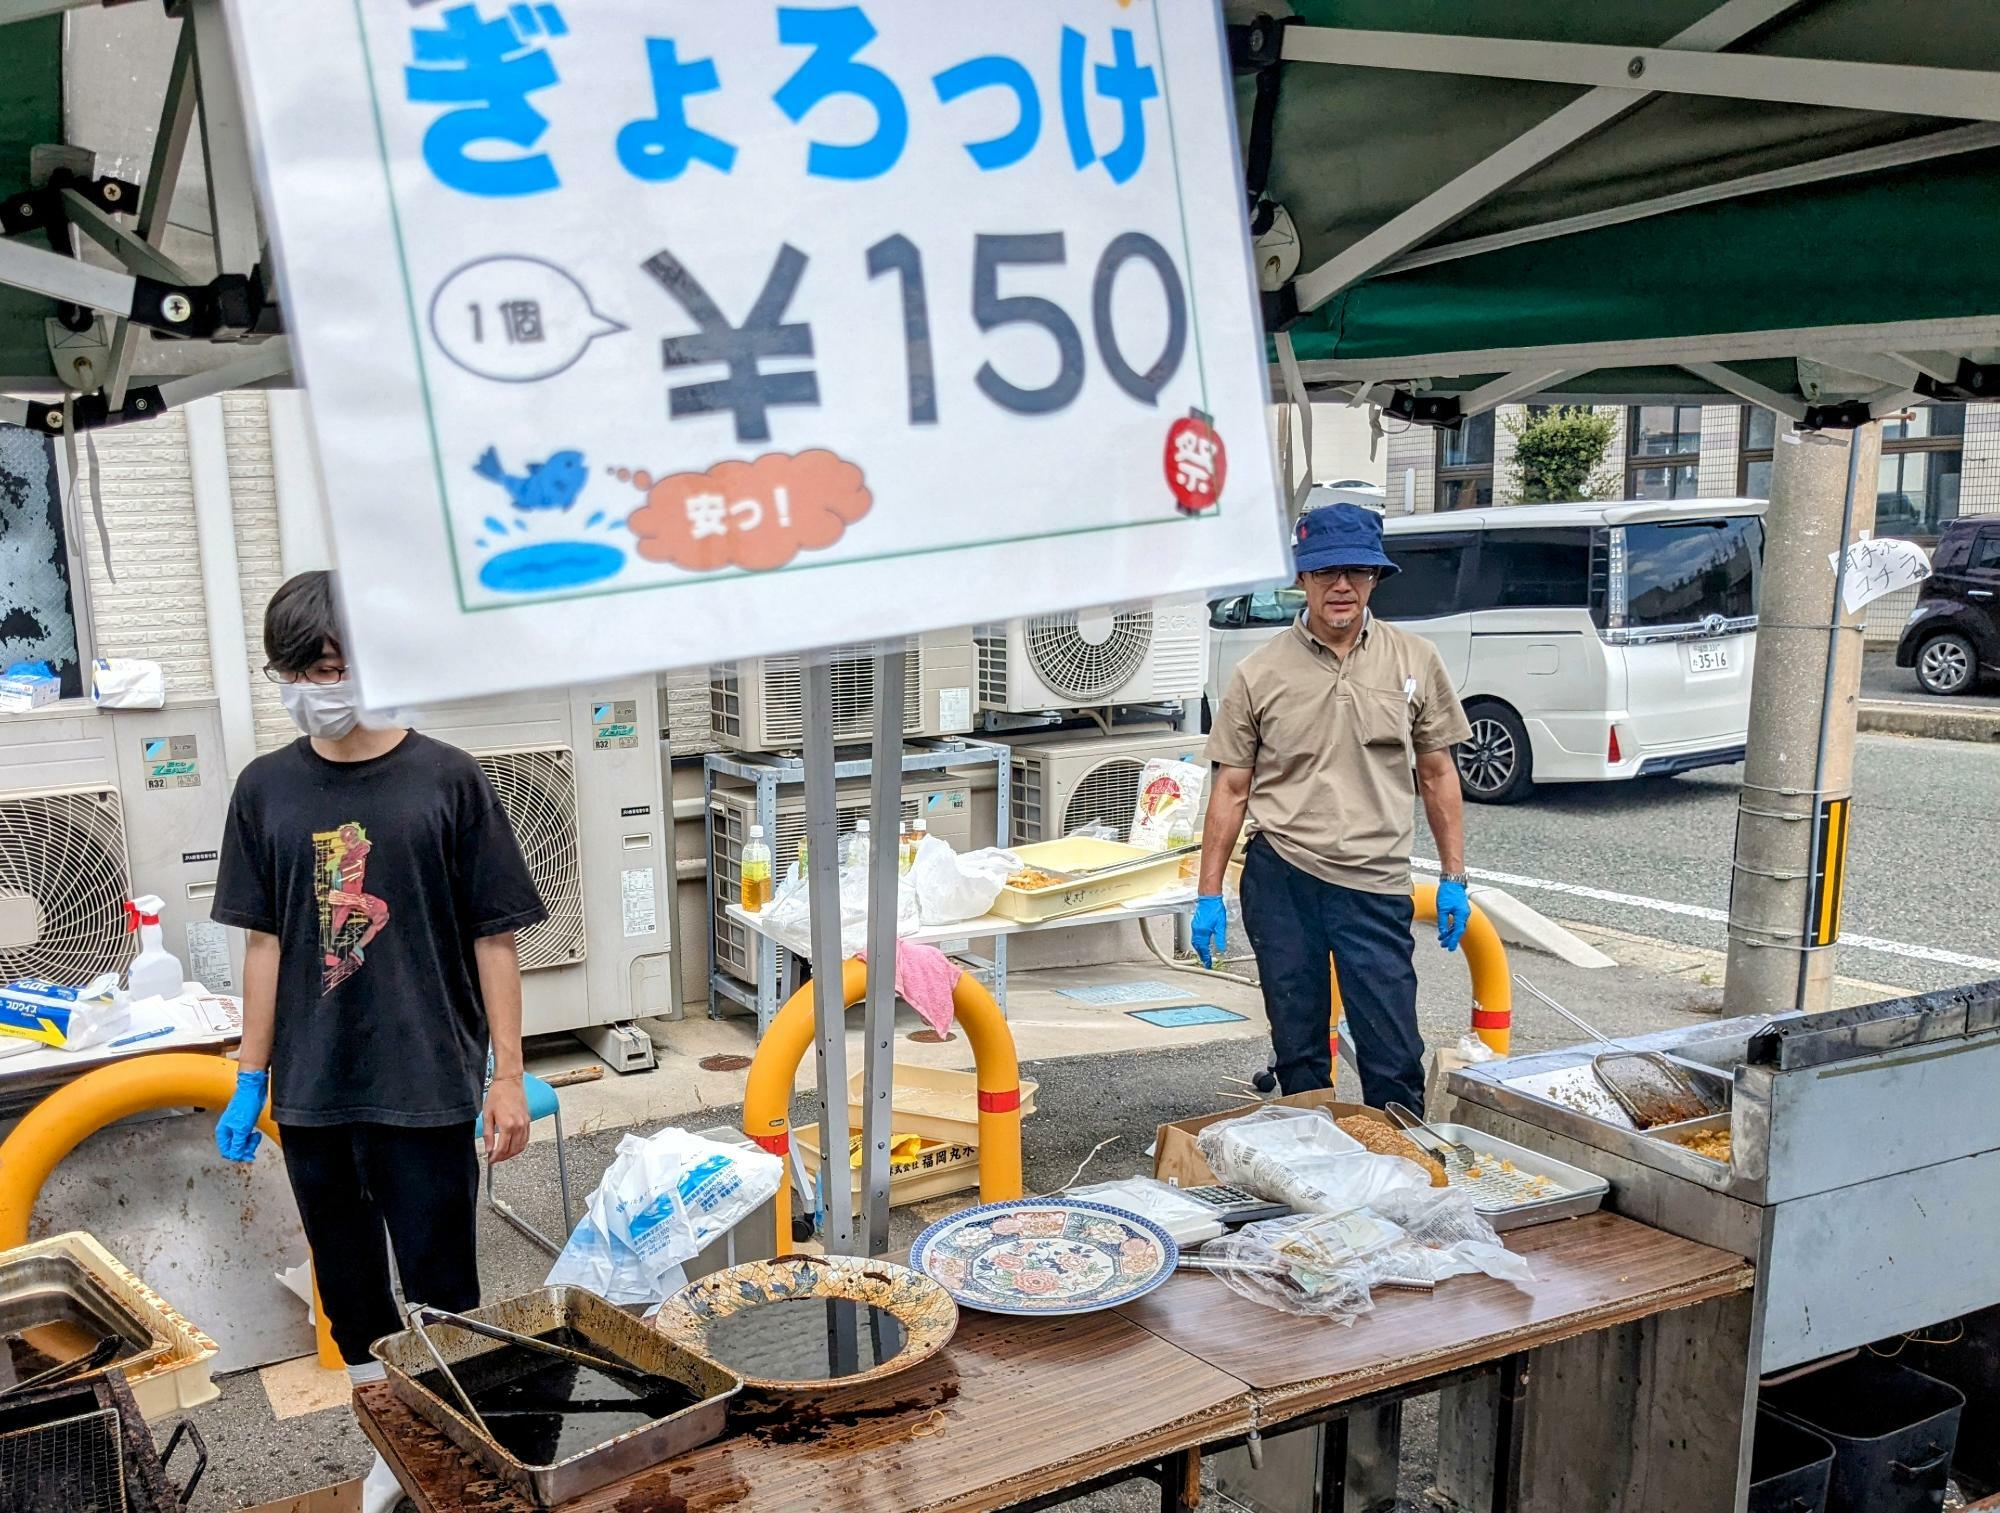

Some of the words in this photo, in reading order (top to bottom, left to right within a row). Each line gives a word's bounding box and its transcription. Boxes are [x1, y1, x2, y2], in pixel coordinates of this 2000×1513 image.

[404, 3, 1160, 197] ぎょろっけ
[466, 298, 546, 347] 1個
[640, 231, 1188, 443] ¥150
[1174, 428, 1218, 498] 祭
[684, 485, 793, 540] 安っ！
[1855, 553, 1917, 600] コチラ
[1698, 652, 1726, 669] 35-16
[148, 779, 165, 789] R32
